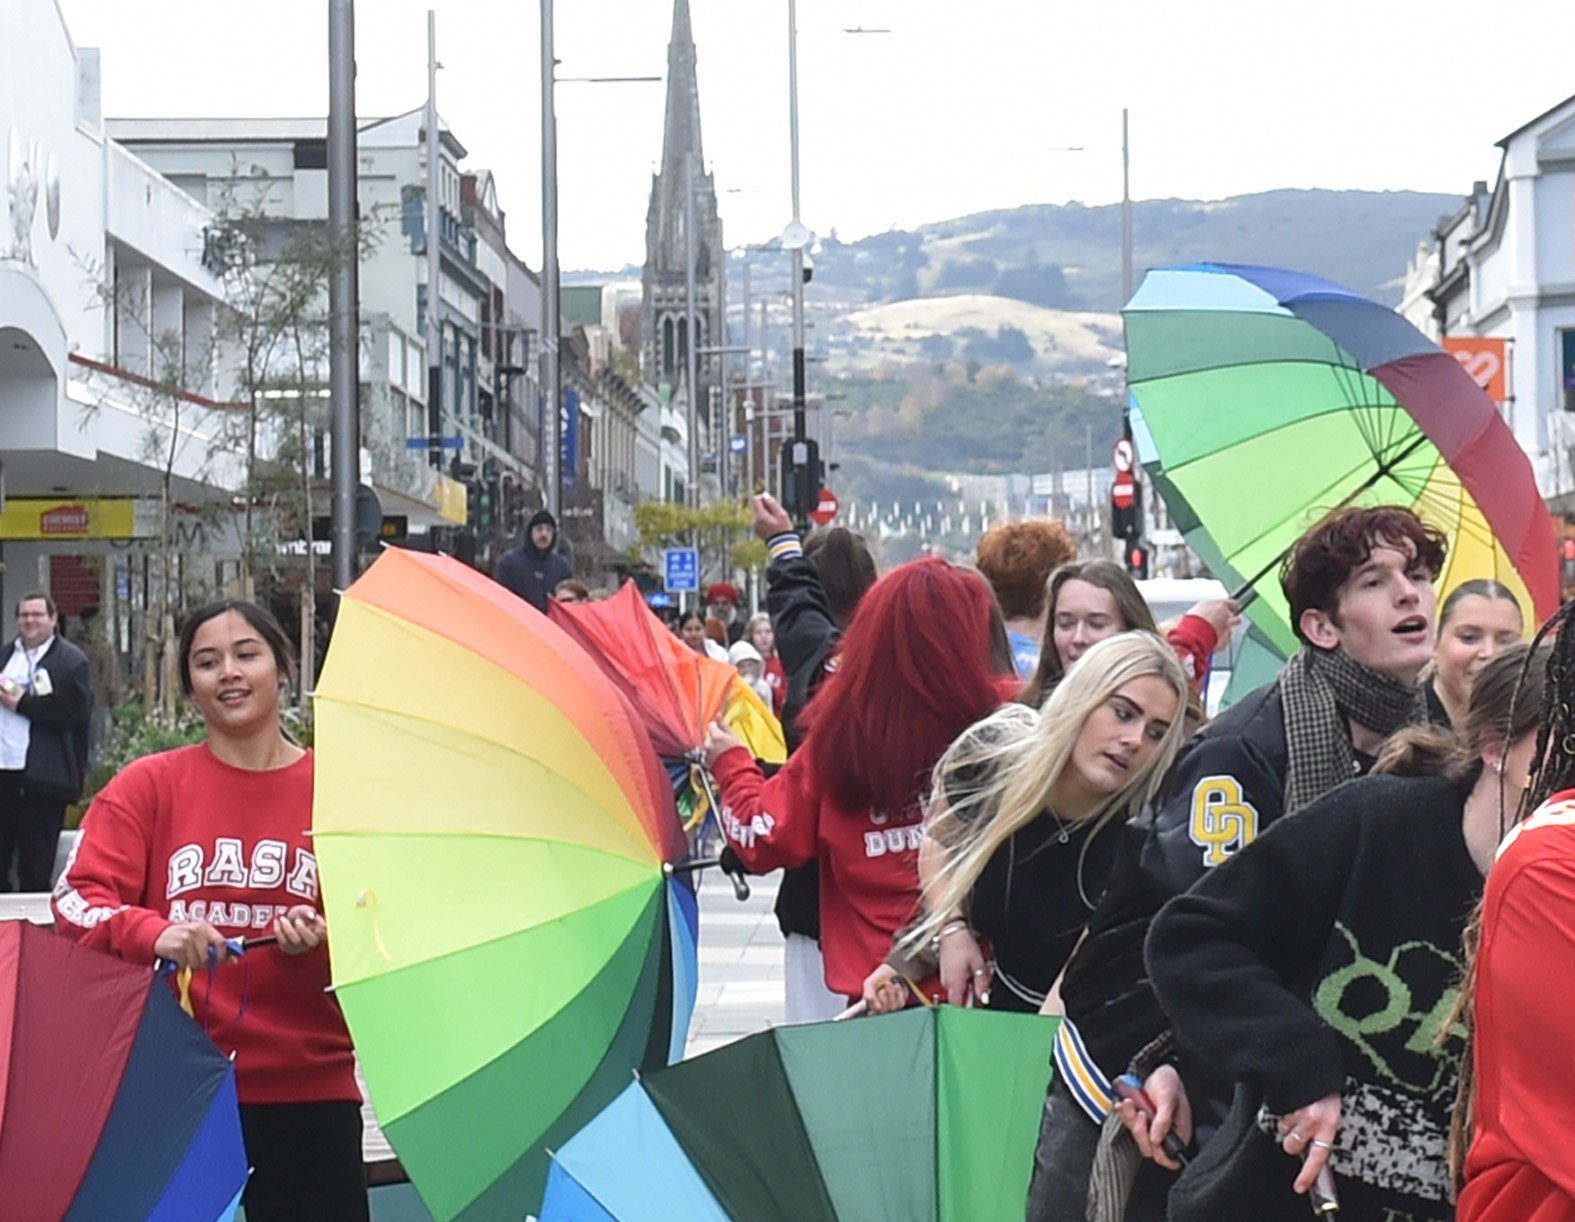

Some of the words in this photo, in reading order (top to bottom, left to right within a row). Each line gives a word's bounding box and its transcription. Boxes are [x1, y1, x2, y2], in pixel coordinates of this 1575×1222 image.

[864, 822, 928, 858] DUN
[166, 837, 319, 901] RASA
[167, 899, 288, 930] ACADE
